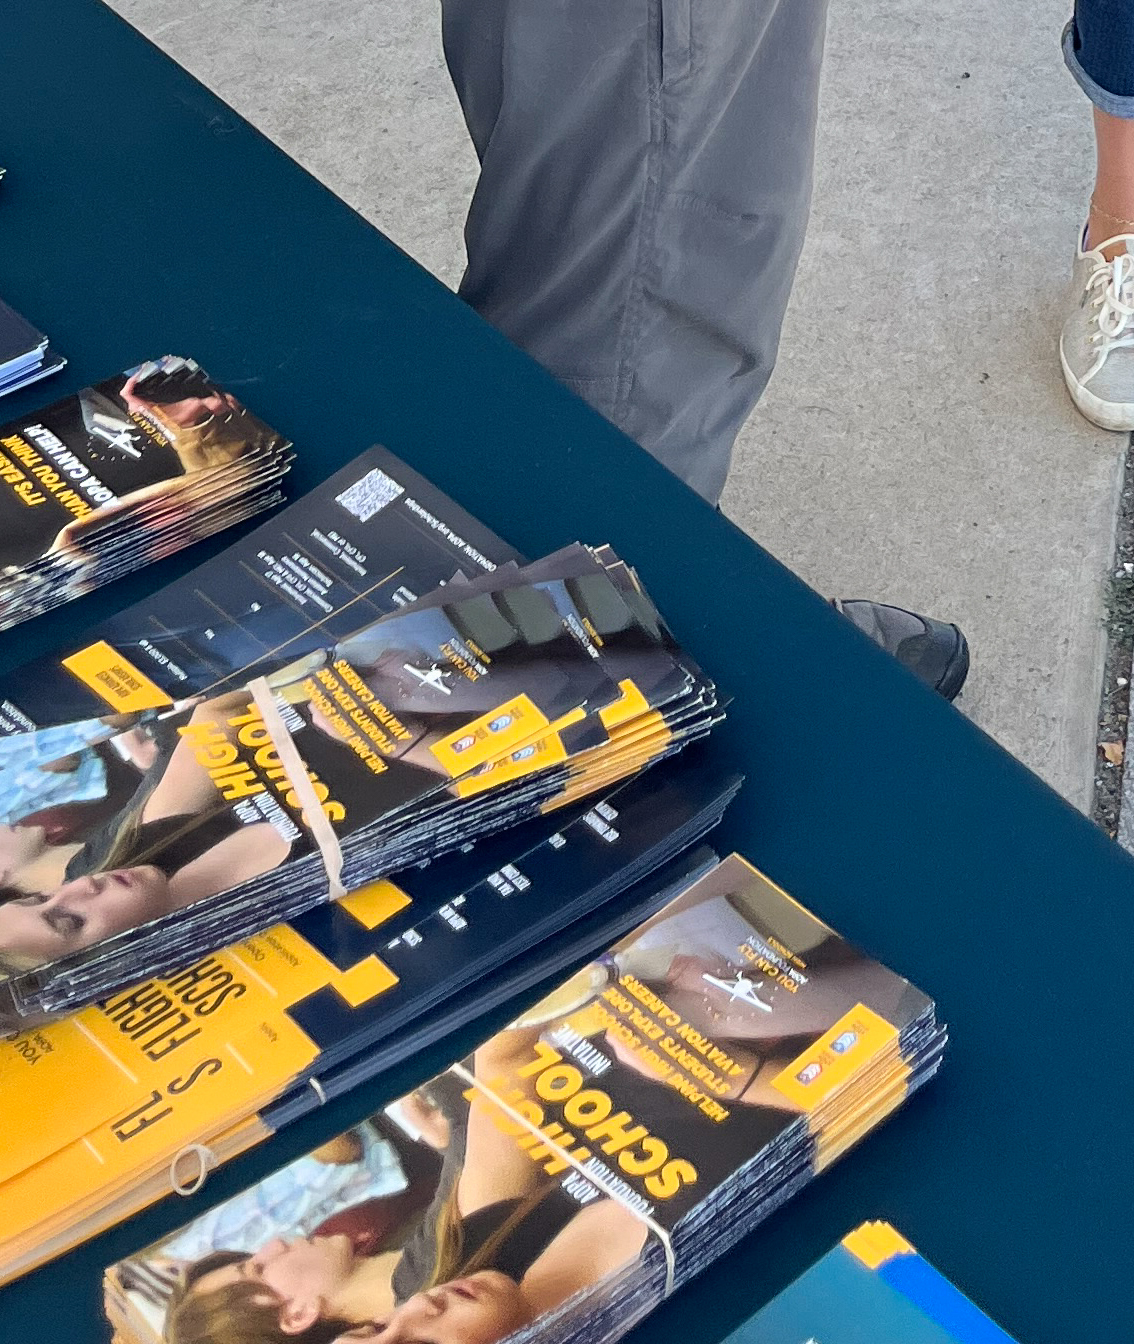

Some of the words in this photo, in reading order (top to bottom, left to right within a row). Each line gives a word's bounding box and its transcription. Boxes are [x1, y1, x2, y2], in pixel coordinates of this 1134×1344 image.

[2, 433, 43, 467] THINK
[22, 423, 68, 454] HELP!
[31, 464, 68, 493] YOU
[53, 450, 91, 478] CAN
[78, 474, 122, 508] AOPA
[299, 676, 337, 716] SCHOOL
[314, 667, 359, 712] EXPLORE
[331, 657, 376, 702] CAREERS
[327, 713, 356, 738] HIGH
[348, 708, 397, 754] STUDENTS
[366, 699, 413, 740] AVIATION
[175, 720, 266, 800] HIGH
[346, 735, 389, 773] HELPING
[231, 798, 263, 823] AOPA
[252, 790, 302, 842] FOUNDATION
[739, 945, 757, 959] FLY
[756, 958, 779, 976] CAN
[615, 972, 685, 1027] CAREERS
[777, 975, 798, 994] YOU
[582, 1000, 645, 1049] SCHOOL
[597, 986, 667, 1040] EXPLORE
[12, 1038, 43, 1065] YOU
[551, 1022, 614, 1076] INITIATIVE
[632, 1043, 675, 1076] HIGH
[655, 1035, 732, 1096] STUDENTS
[673, 1021, 745, 1078] AVIATION
[666, 1071, 731, 1122] HELPING
[458, 1074, 594, 1175] HIGH
[513, 1039, 696, 1199] SCHOOL
[559, 1170, 601, 1202] AOPA
